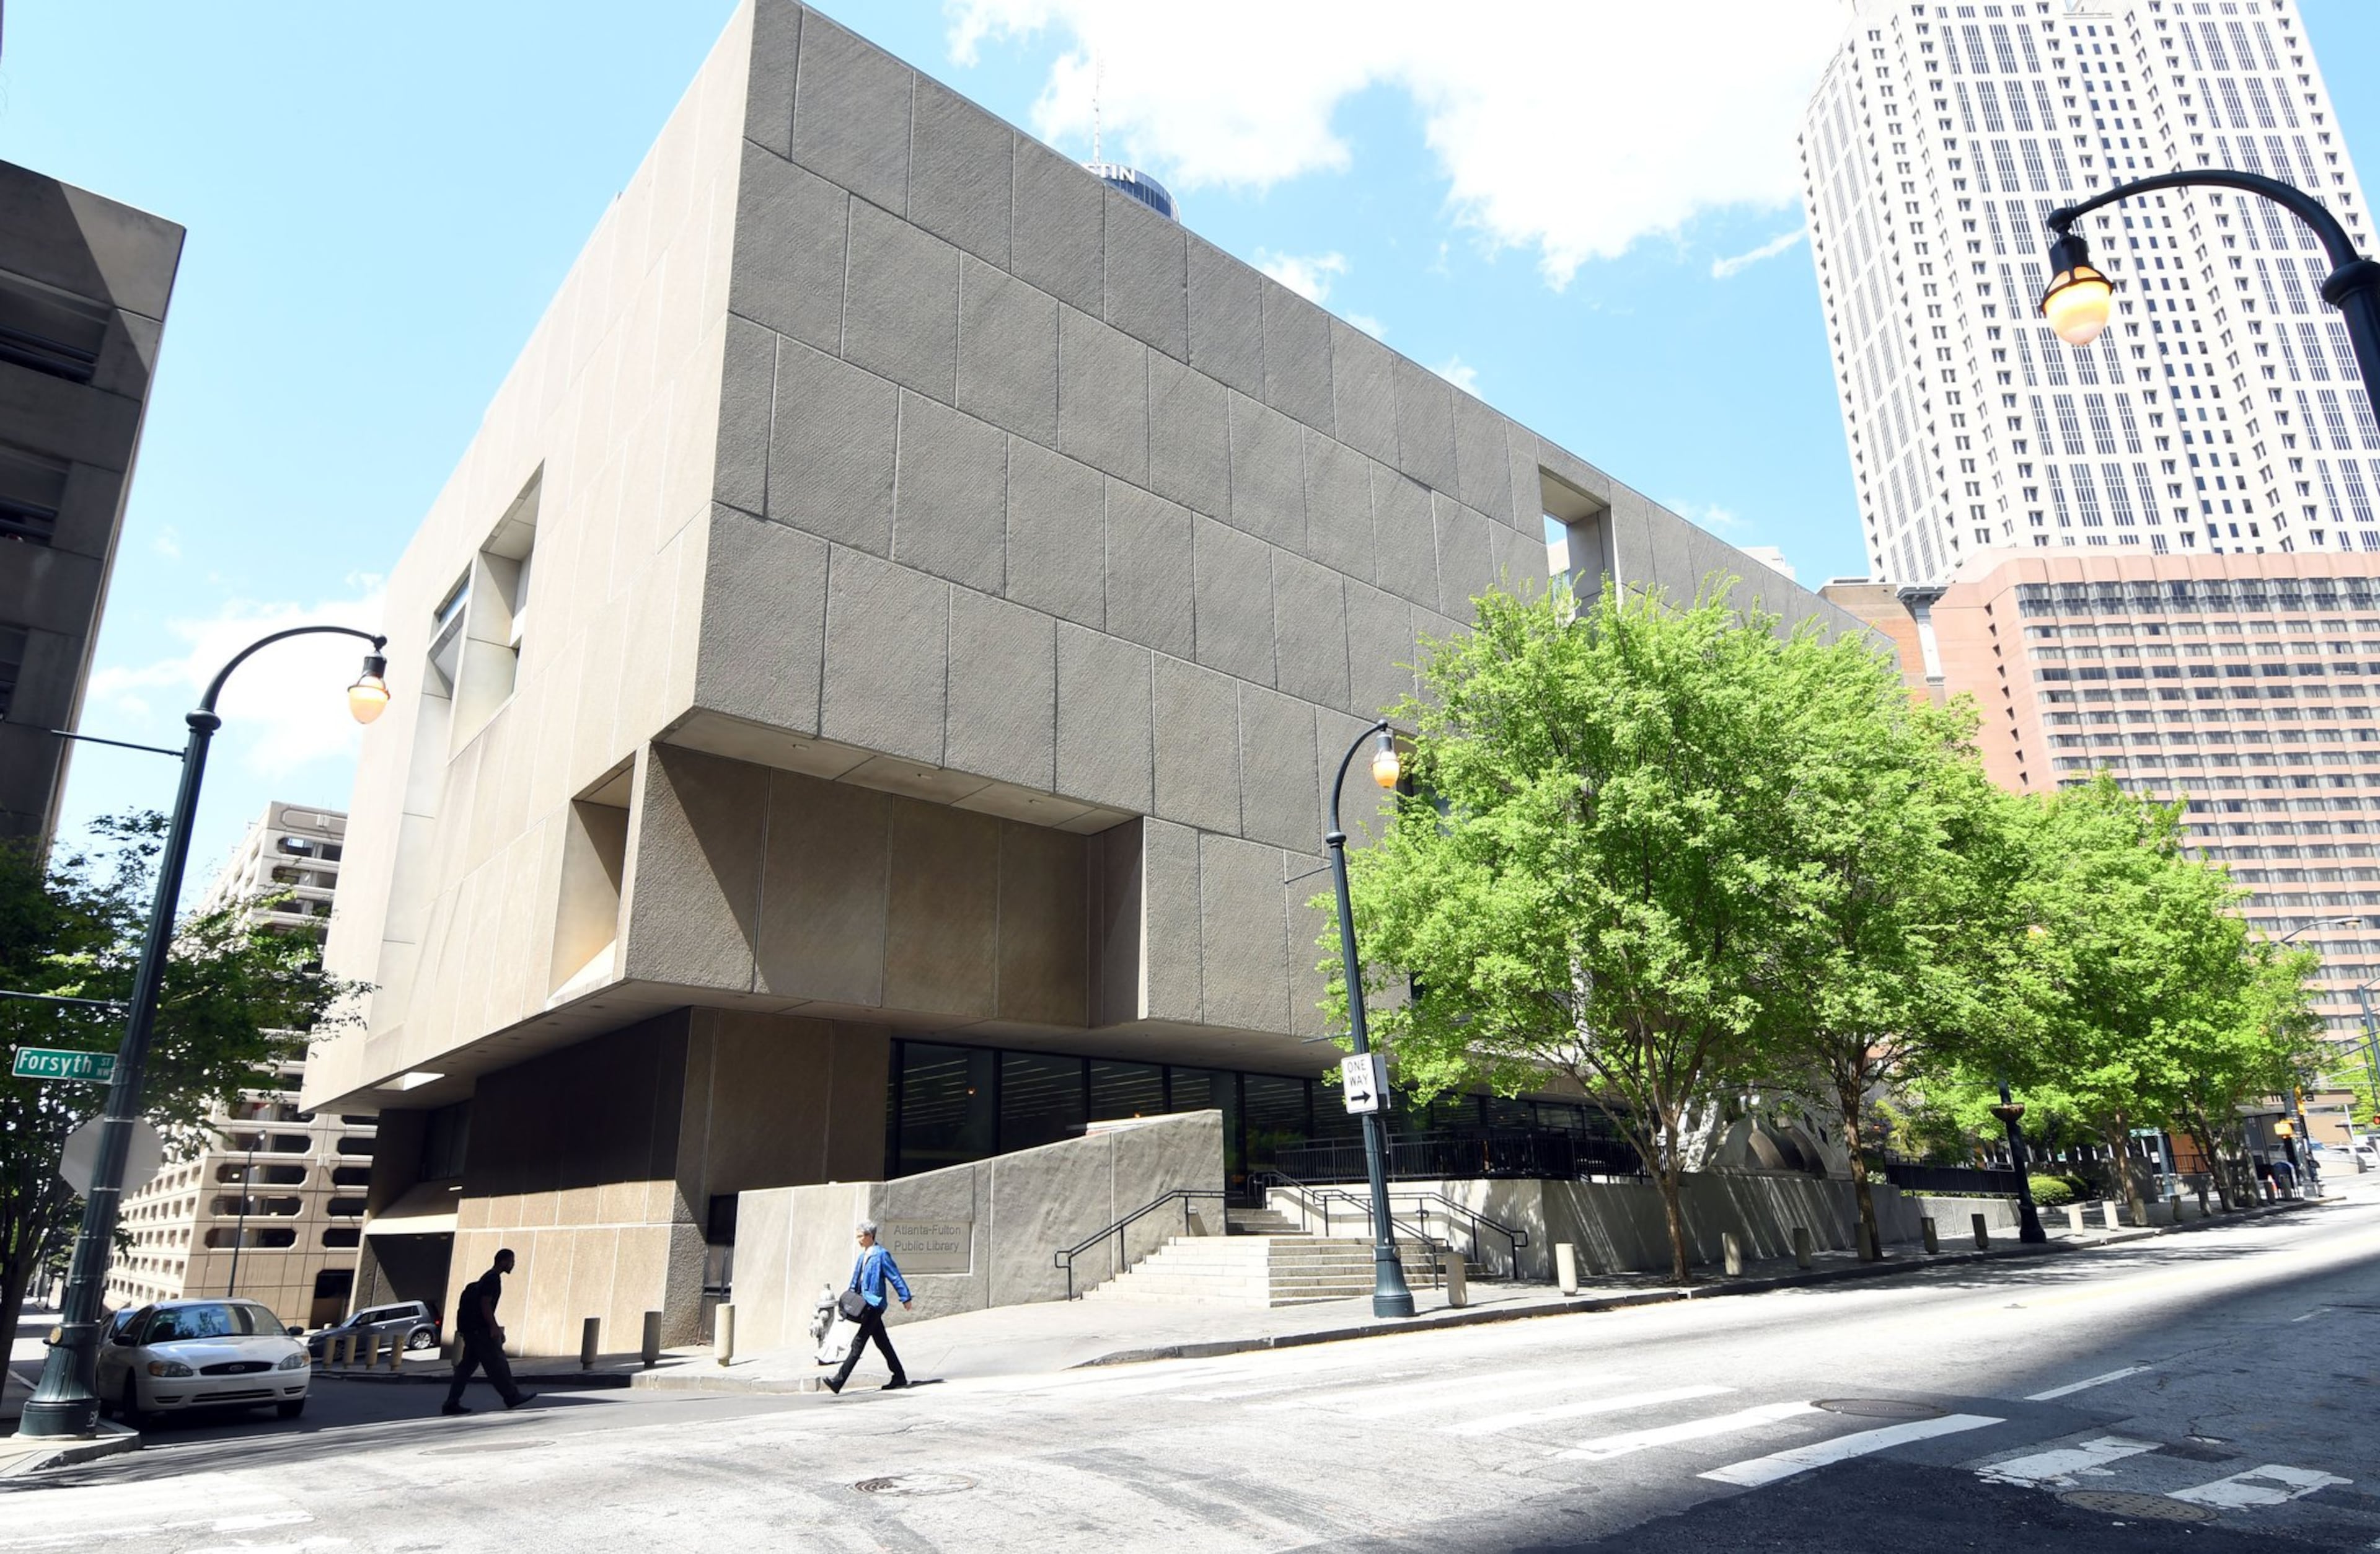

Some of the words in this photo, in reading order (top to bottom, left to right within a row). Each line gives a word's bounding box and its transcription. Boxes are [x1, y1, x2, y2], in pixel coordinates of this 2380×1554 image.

[17, 1051, 92, 1077] Forsyth
[100, 1057, 111, 1066] ST
[1347, 1059, 1367, 1074] ONE
[97, 1068, 110, 1077] NW
[1350, 1074, 1368, 1086] WAY
[894, 1224, 961, 1235] Atlanta-Fulton
[894, 1240, 923, 1251] Public
[927, 1240, 959, 1253] Library
